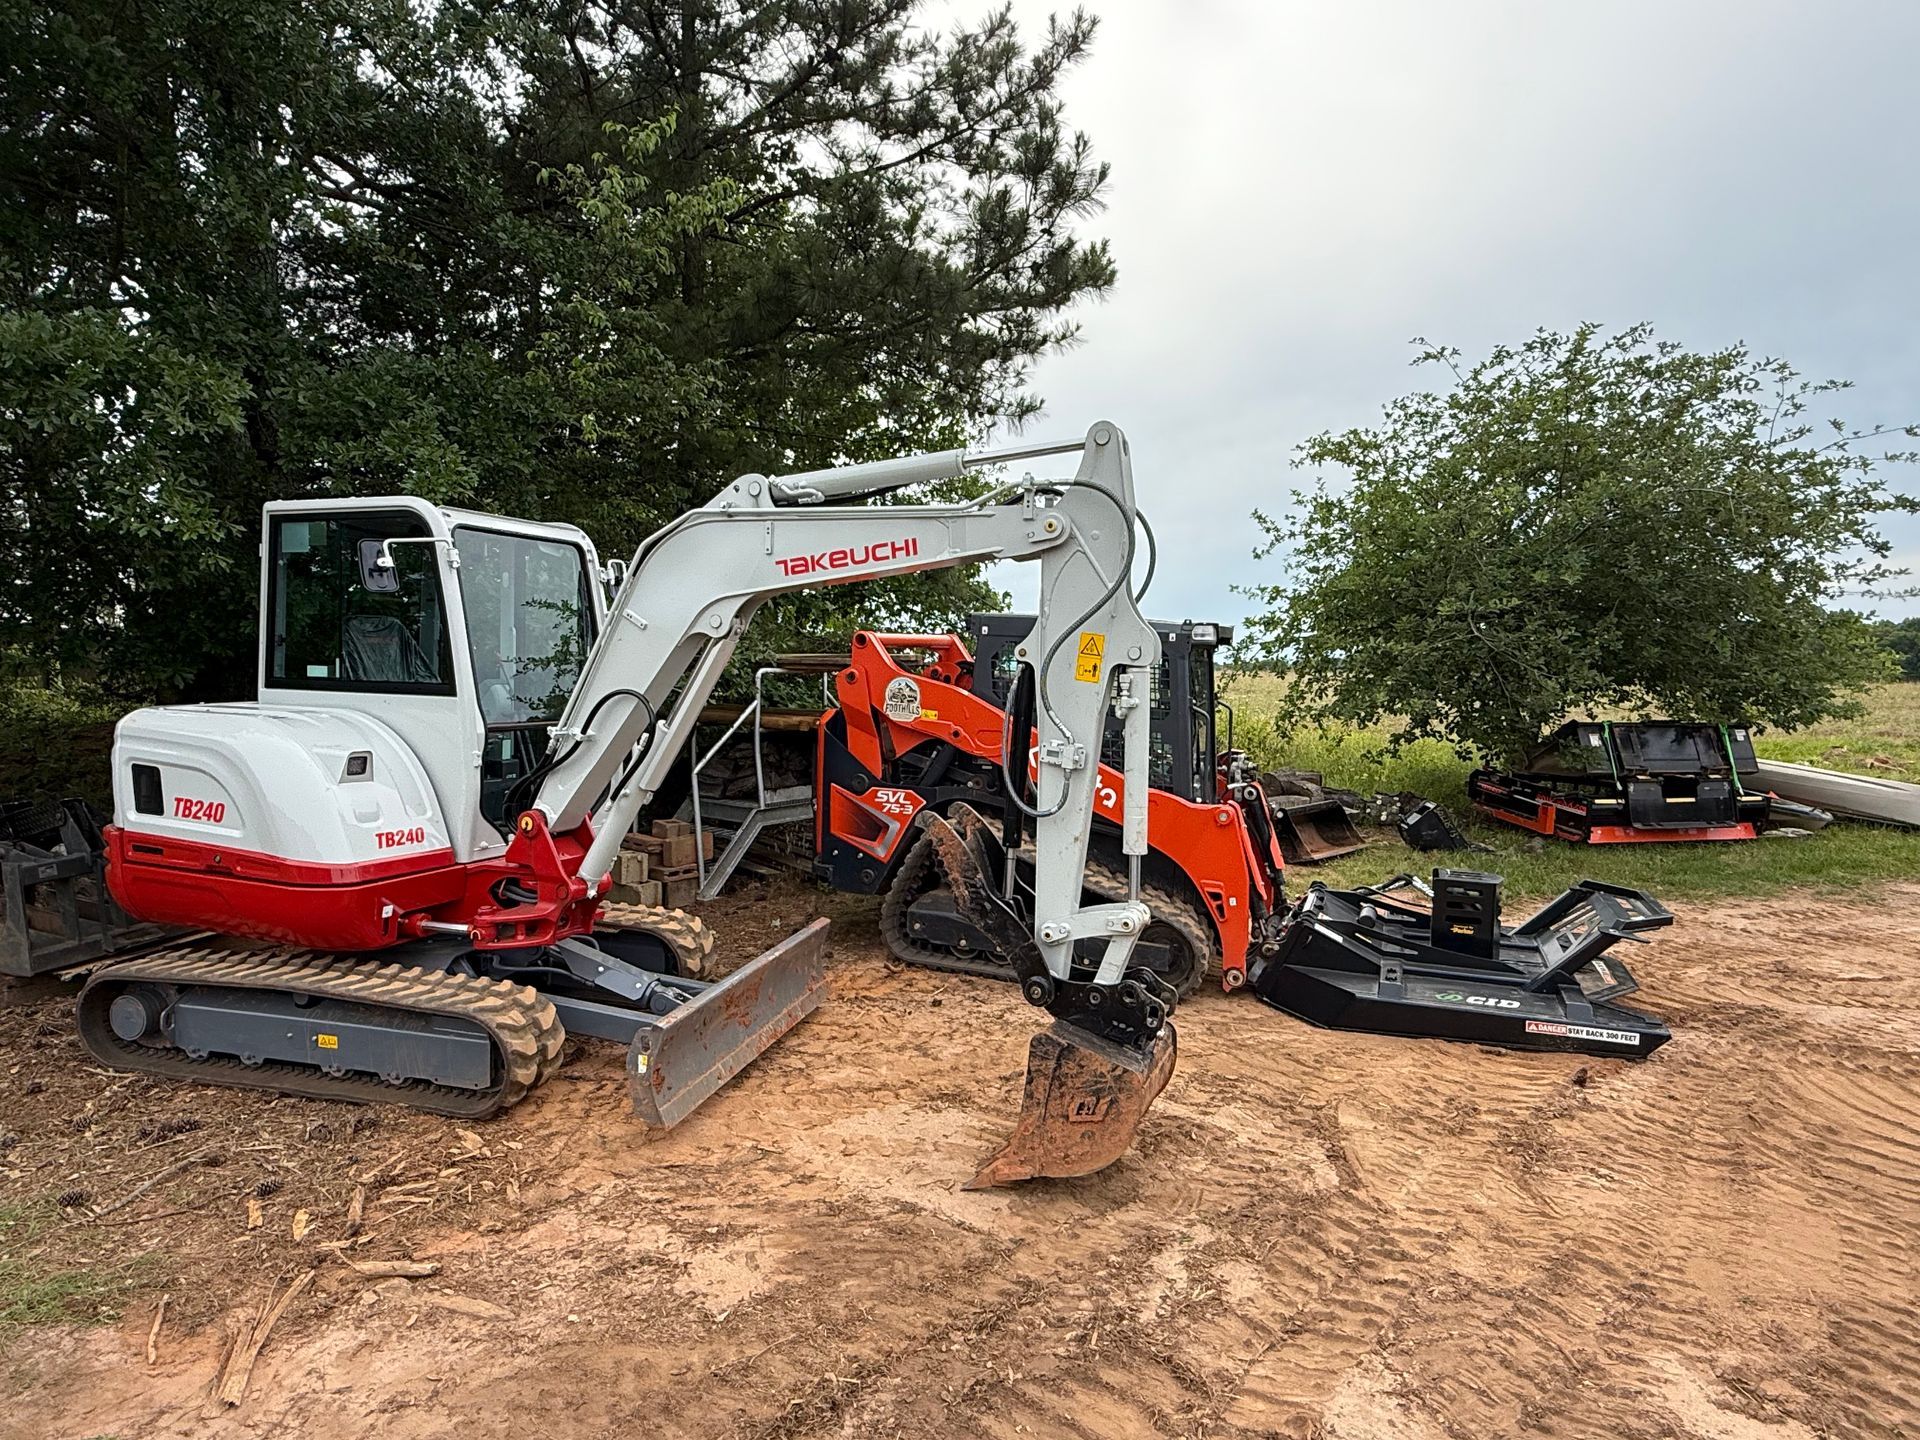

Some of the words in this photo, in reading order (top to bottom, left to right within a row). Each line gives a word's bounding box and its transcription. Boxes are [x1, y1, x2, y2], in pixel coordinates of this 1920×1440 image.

[885, 703, 920, 716] FOOTHILLS
[874, 790, 911, 805] SVL
[174, 797, 225, 823] TB240
[881, 803, 914, 815] 75-3
[375, 827, 425, 849] TB240
[1466, 996, 1520, 1009] CID
[1538, 1024, 1567, 1034] DANGER
[1567, 1027, 1584, 1036] STAY
[1585, 1029, 1604, 1038] BACK
[1606, 1032, 1619, 1040] 300
[1620, 1034, 1637, 1042] FEET
